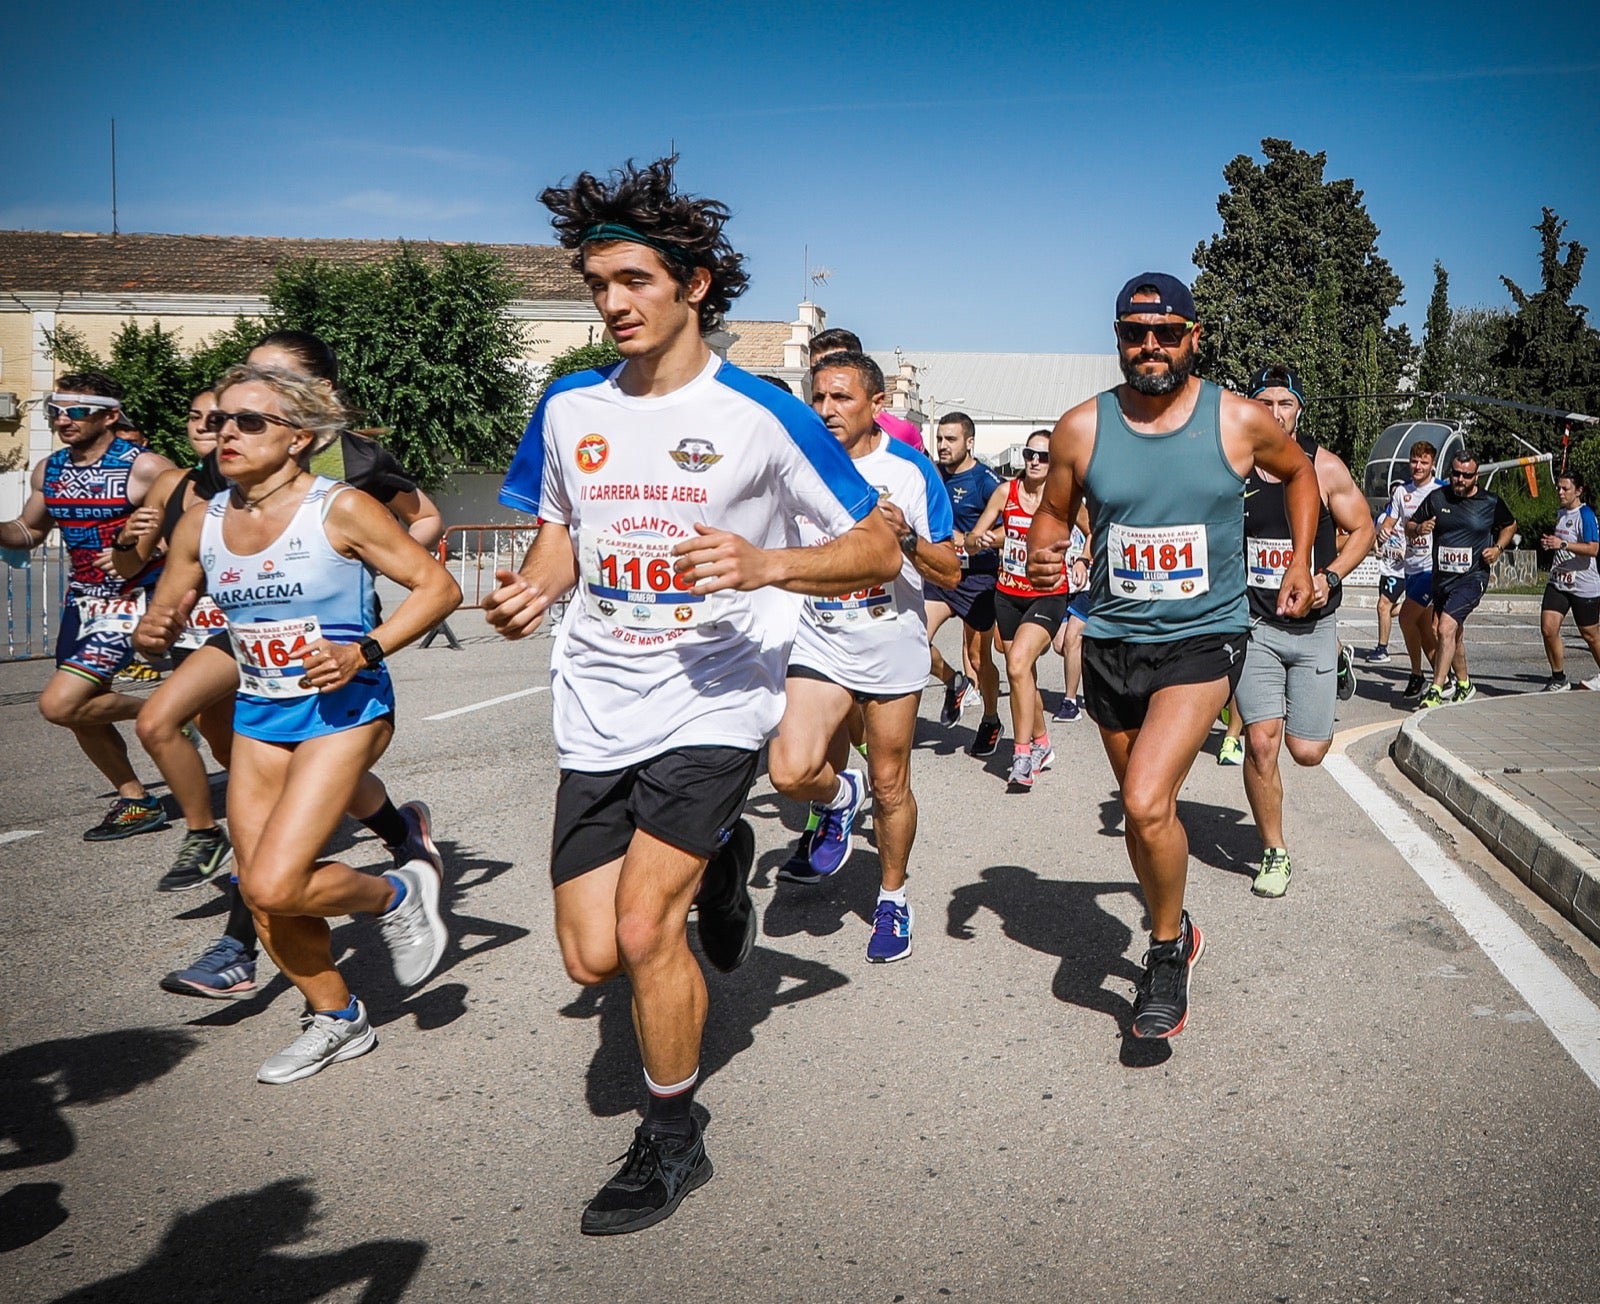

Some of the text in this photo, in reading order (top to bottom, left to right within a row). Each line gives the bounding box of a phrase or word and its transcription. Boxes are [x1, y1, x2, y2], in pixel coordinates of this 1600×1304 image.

[580, 484, 708, 503] II CARRERA BASE AEREA
[75, 508, 124, 518] SPORT
[606, 539, 643, 550] CARRERA
[1127, 531, 1156, 539] CARRERA
[1124, 543, 1194, 570] 1181
[1444, 552, 1469, 563] 1018
[602, 554, 697, 591] 1168
[612, 627, 623, 638] 29
[624, 633, 637, 644] DE
[639, 635, 664, 646] MAYO
[240, 636, 312, 667] 1164
